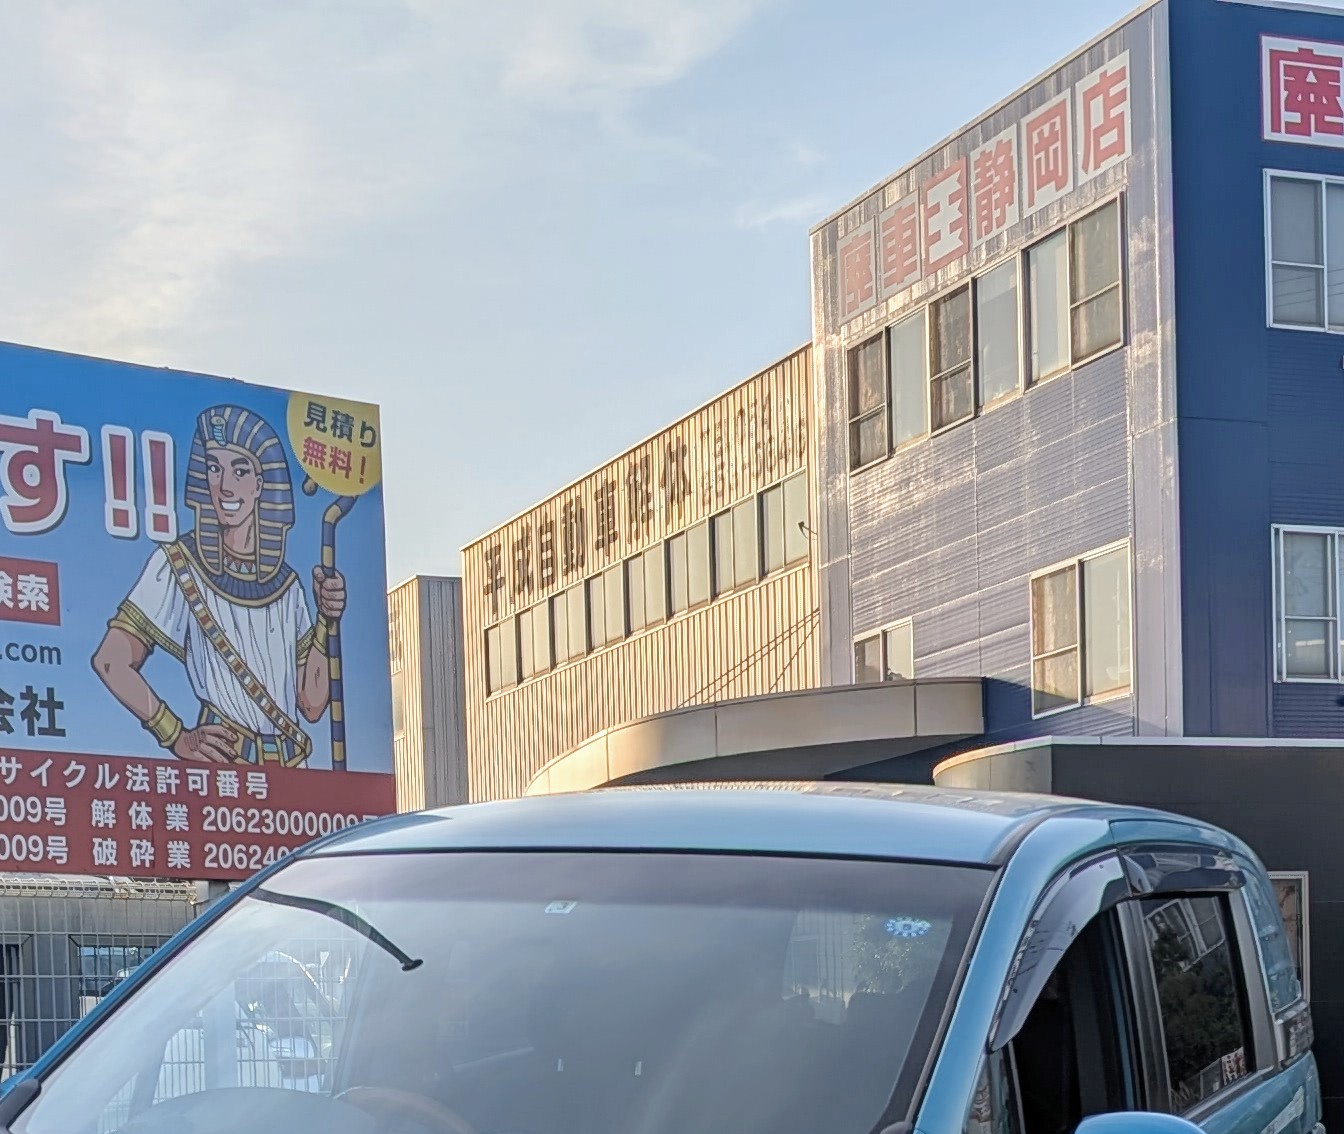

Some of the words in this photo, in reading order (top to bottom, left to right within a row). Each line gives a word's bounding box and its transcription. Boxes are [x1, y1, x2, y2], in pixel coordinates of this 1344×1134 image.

[838, 52, 1130, 322] 廃車王静岡店
[304, 401, 377, 448] 見積り
[91, 799, 189, 832] 解体業
[202, 806, 380, 836] 2062300000
[93, 837, 191, 870] 破砕業
